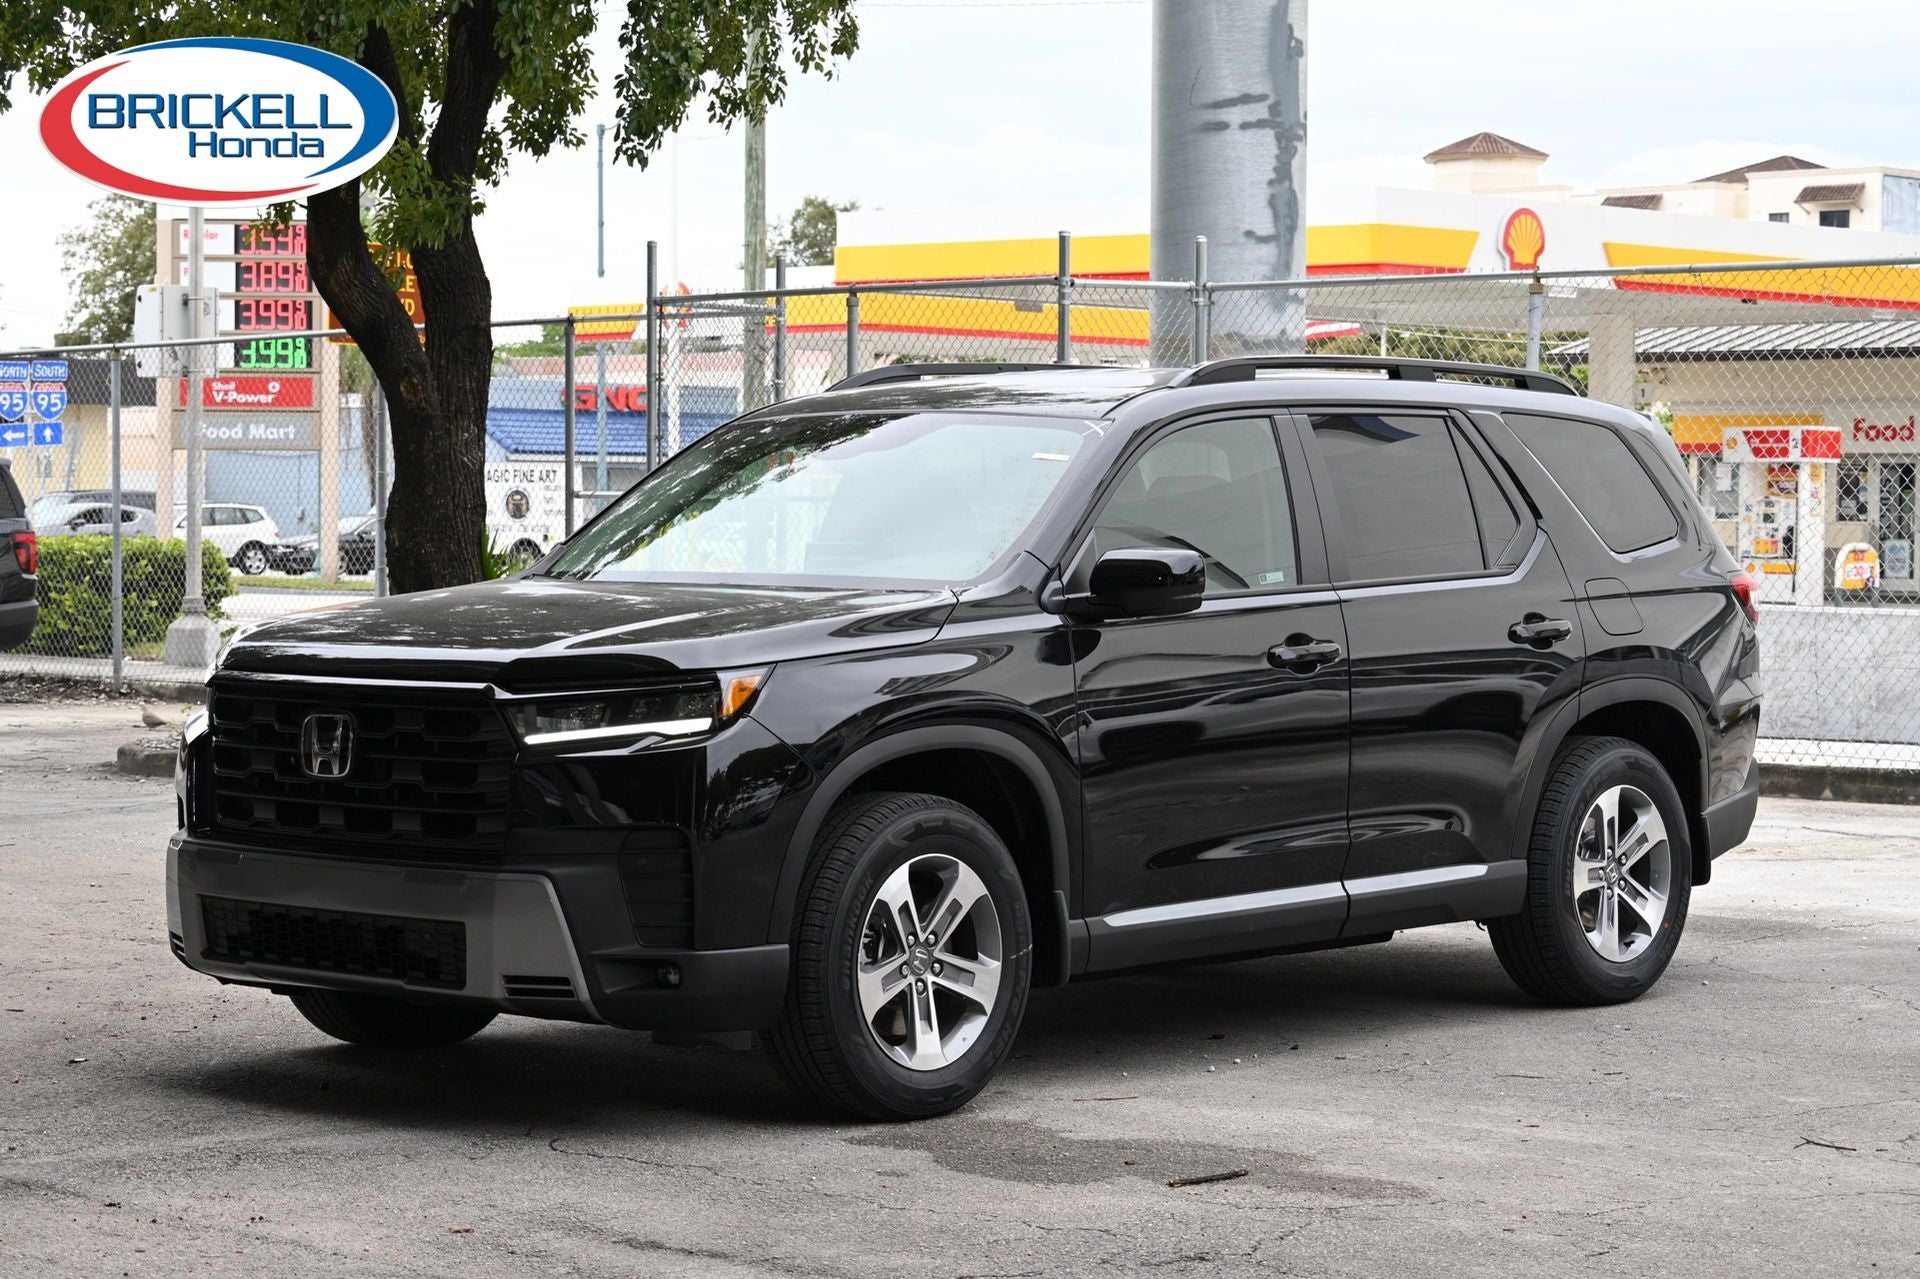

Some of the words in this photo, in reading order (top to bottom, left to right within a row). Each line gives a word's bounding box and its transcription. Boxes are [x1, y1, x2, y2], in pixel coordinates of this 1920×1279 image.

[240, 261, 294, 292] 3.89
[240, 299, 293, 330] 3.99
[35, 364, 65, 377] SOUTH
[0, 393, 24, 411] 95
[37, 393, 62, 411] 95
[213, 391, 274, 403] V-Power
[249, 424, 295, 439] Mart
[513, 469, 535, 483] FINE
